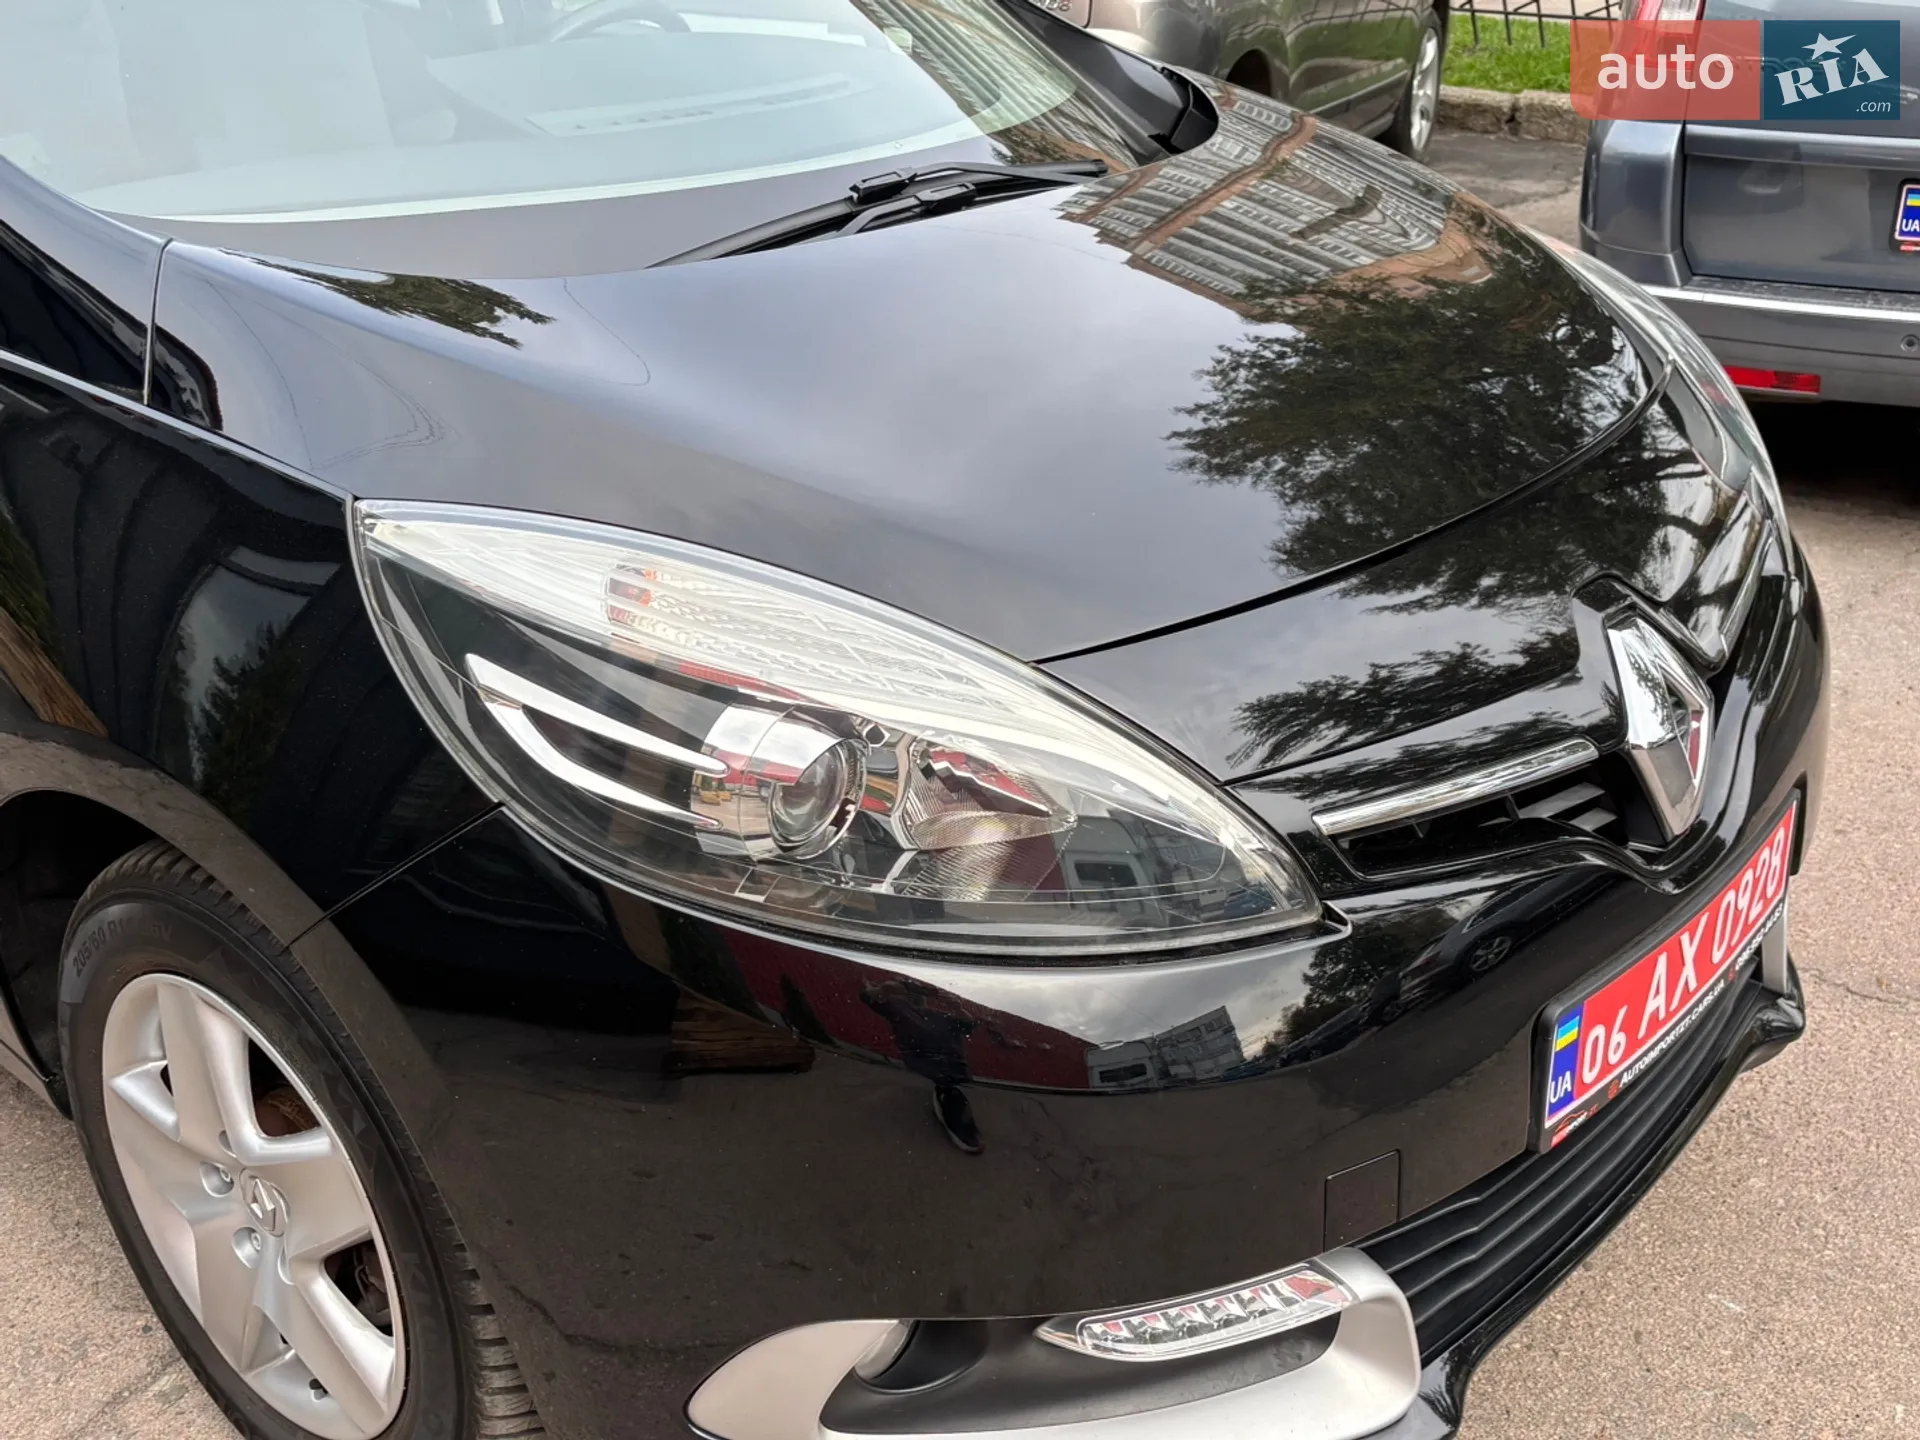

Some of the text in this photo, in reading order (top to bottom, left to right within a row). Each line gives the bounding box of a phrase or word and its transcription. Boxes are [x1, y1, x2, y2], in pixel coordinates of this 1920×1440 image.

[1902, 219, 1920, 232] UA
[1581, 1005, 1628, 1085] 06
[1638, 912, 1709, 1038] AX
[1711, 826, 1786, 965] 0928
[1550, 1072, 1572, 1104] UA
